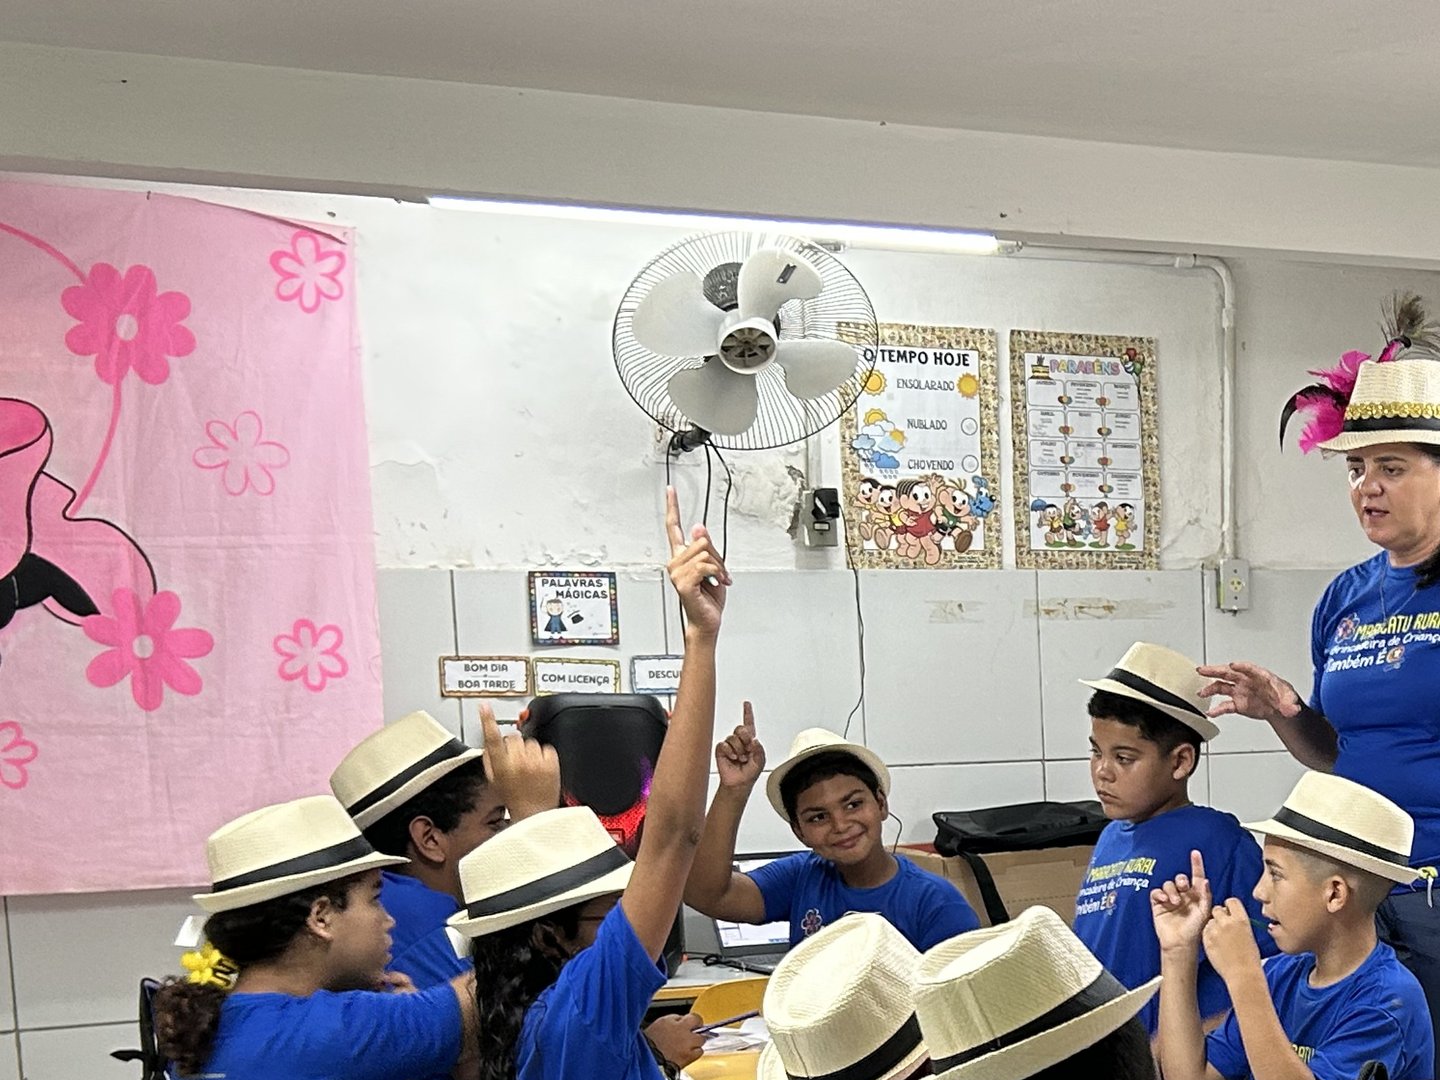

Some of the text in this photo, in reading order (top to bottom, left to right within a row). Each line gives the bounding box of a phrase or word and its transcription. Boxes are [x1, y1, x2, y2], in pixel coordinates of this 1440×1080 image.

[880, 349, 928, 364] TEMPO
[933, 352, 970, 367] HOJE
[1050, 358, 1121, 376] PARABÉNS
[897, 378, 955, 391] ENSOLARADO
[907, 418, 947, 430] NUBLADO
[908, 459, 955, 470] CHOVENDO
[541, 578, 603, 588] PALAVRAS
[556, 588, 608, 599] MÁGICAS
[464, 663, 508, 673] BOM DIA
[541, 673, 610, 686] COM LICENÇA
[648, 670, 682, 679] DESCU
[458, 679, 516, 689] BOA TARDE
